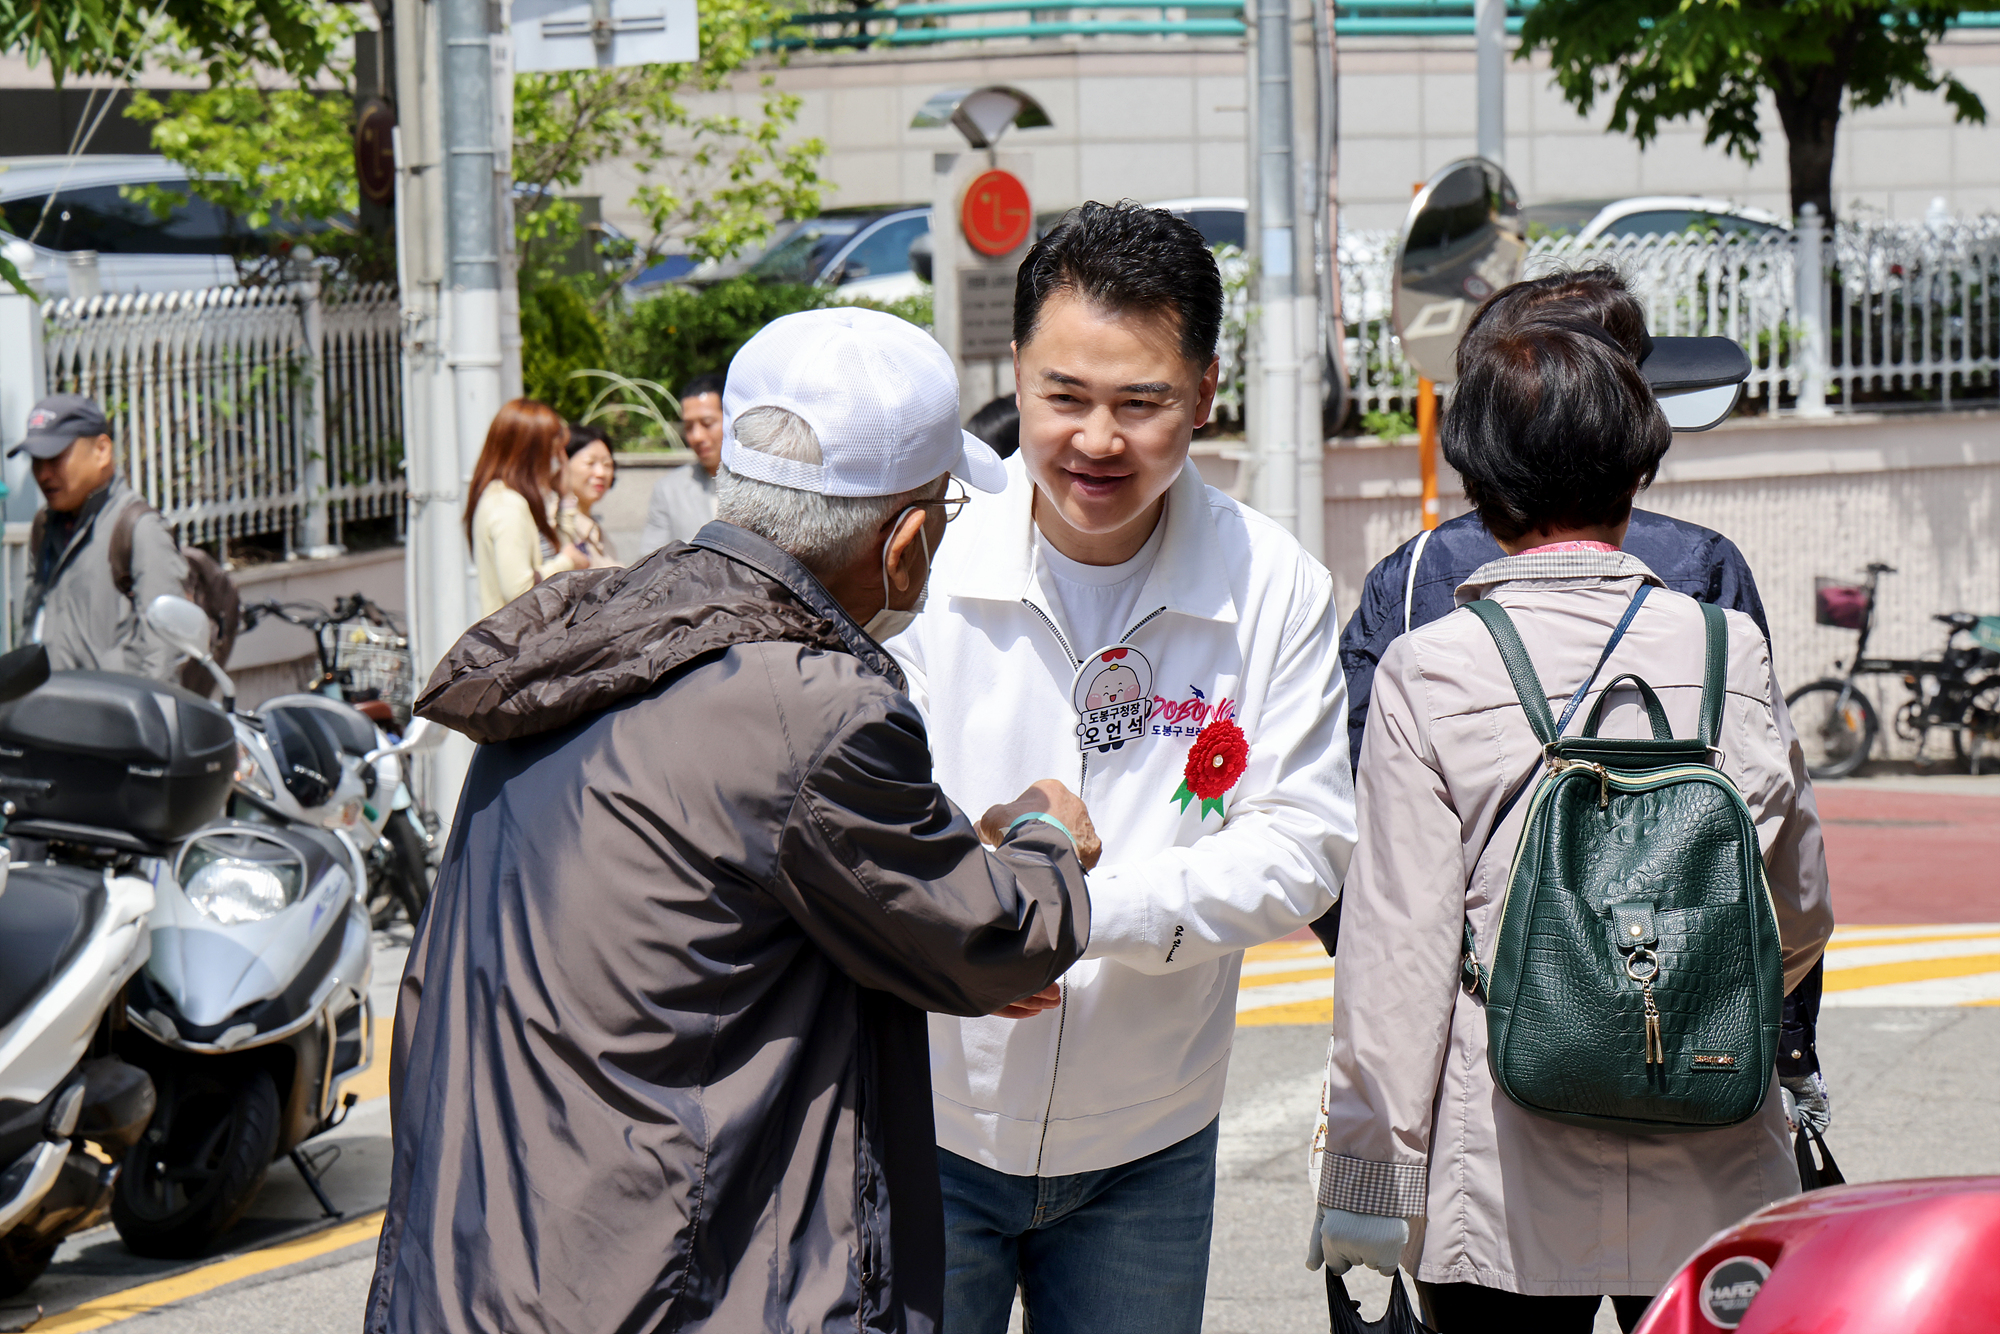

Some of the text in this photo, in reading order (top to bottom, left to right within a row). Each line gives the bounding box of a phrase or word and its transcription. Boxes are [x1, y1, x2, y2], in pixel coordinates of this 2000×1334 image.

[1089, 702, 1140, 724] 도봉구청장
[1148, 695, 1235, 727] DOBONG
[1151, 725, 1183, 737] 도봉구
